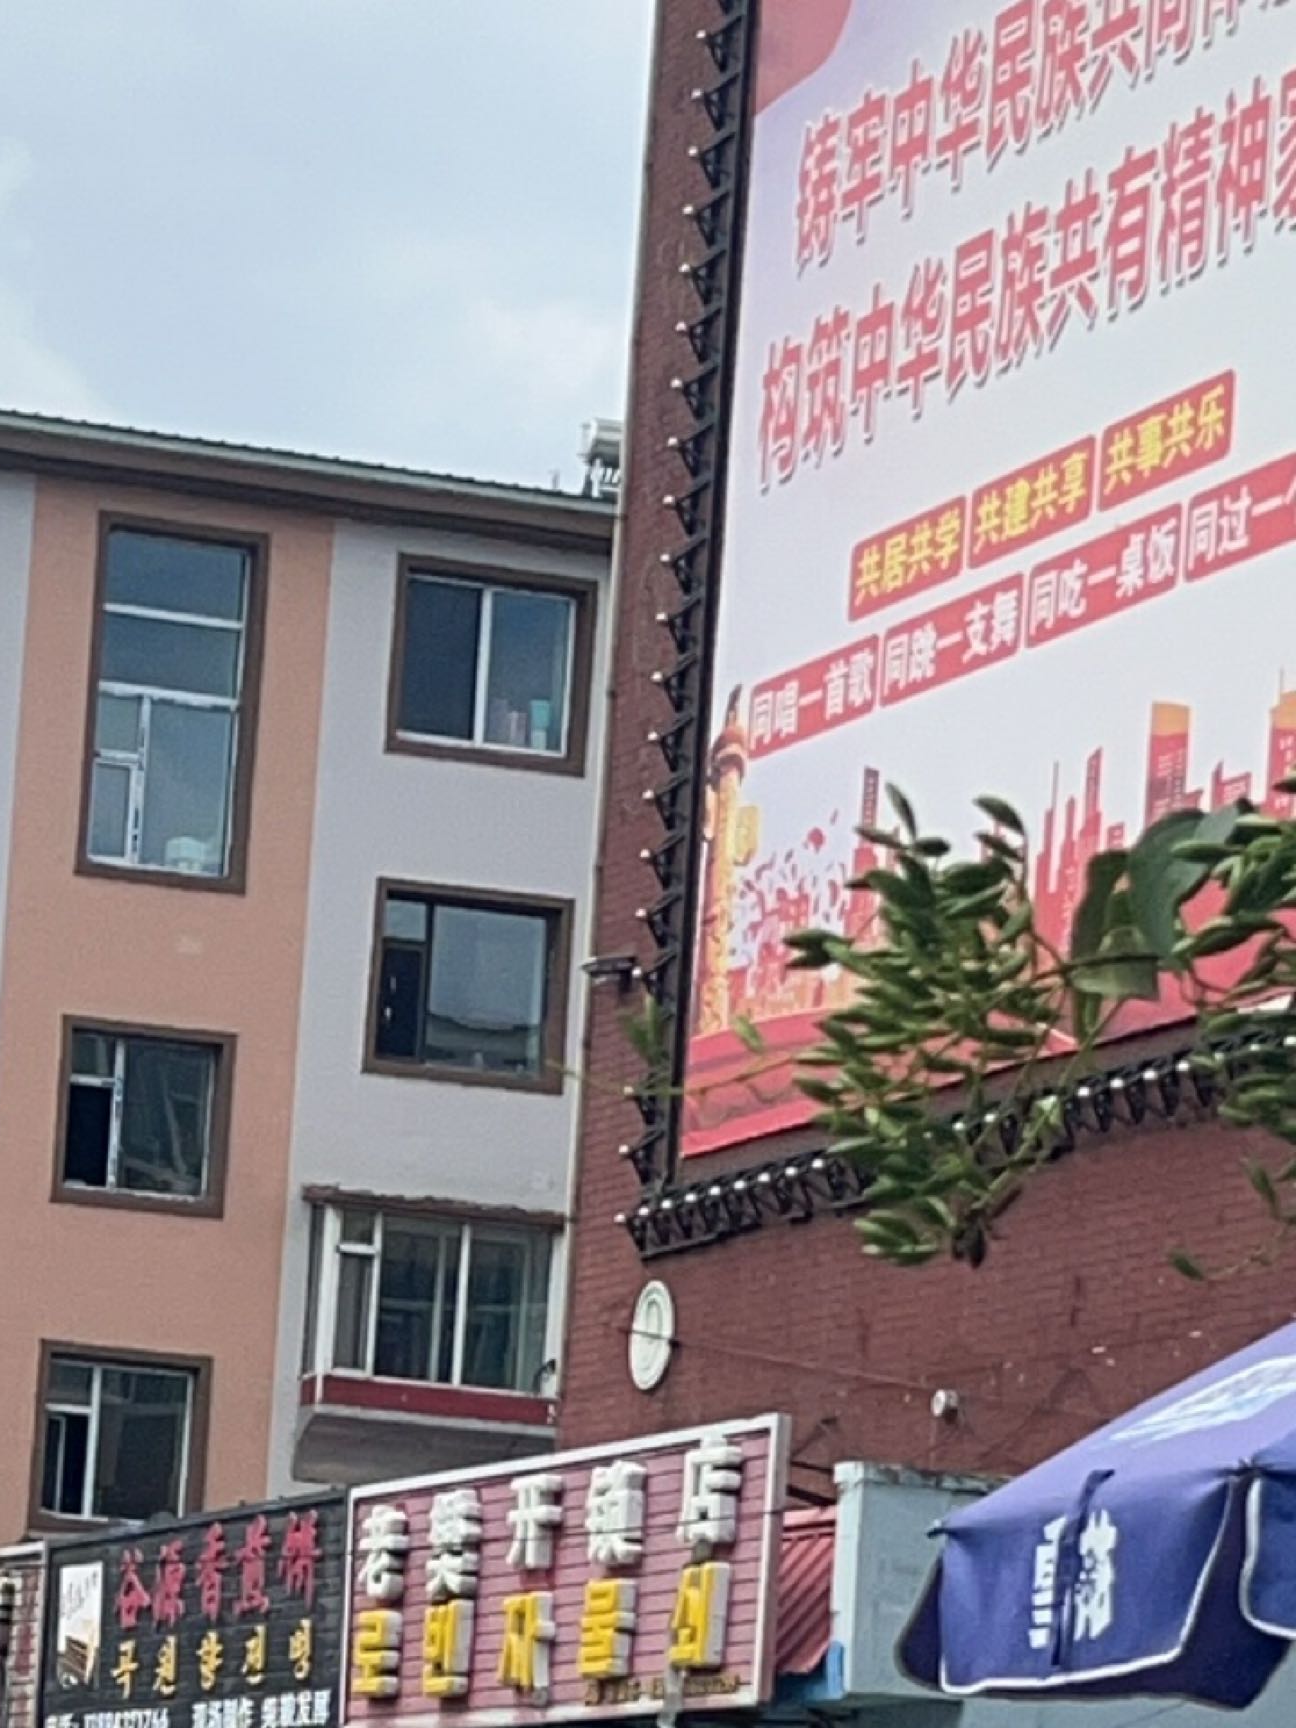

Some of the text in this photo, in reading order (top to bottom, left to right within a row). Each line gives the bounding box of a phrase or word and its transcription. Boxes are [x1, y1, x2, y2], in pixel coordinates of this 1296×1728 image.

[855, 384, 1226, 606] 共居共学 共建共享 共事共乐
[750, 652, 873, 750] 同唱一首歌
[882, 590, 1018, 698] 同跳一支舞
[1029, 523, 1175, 636] 同吃一桌饭
